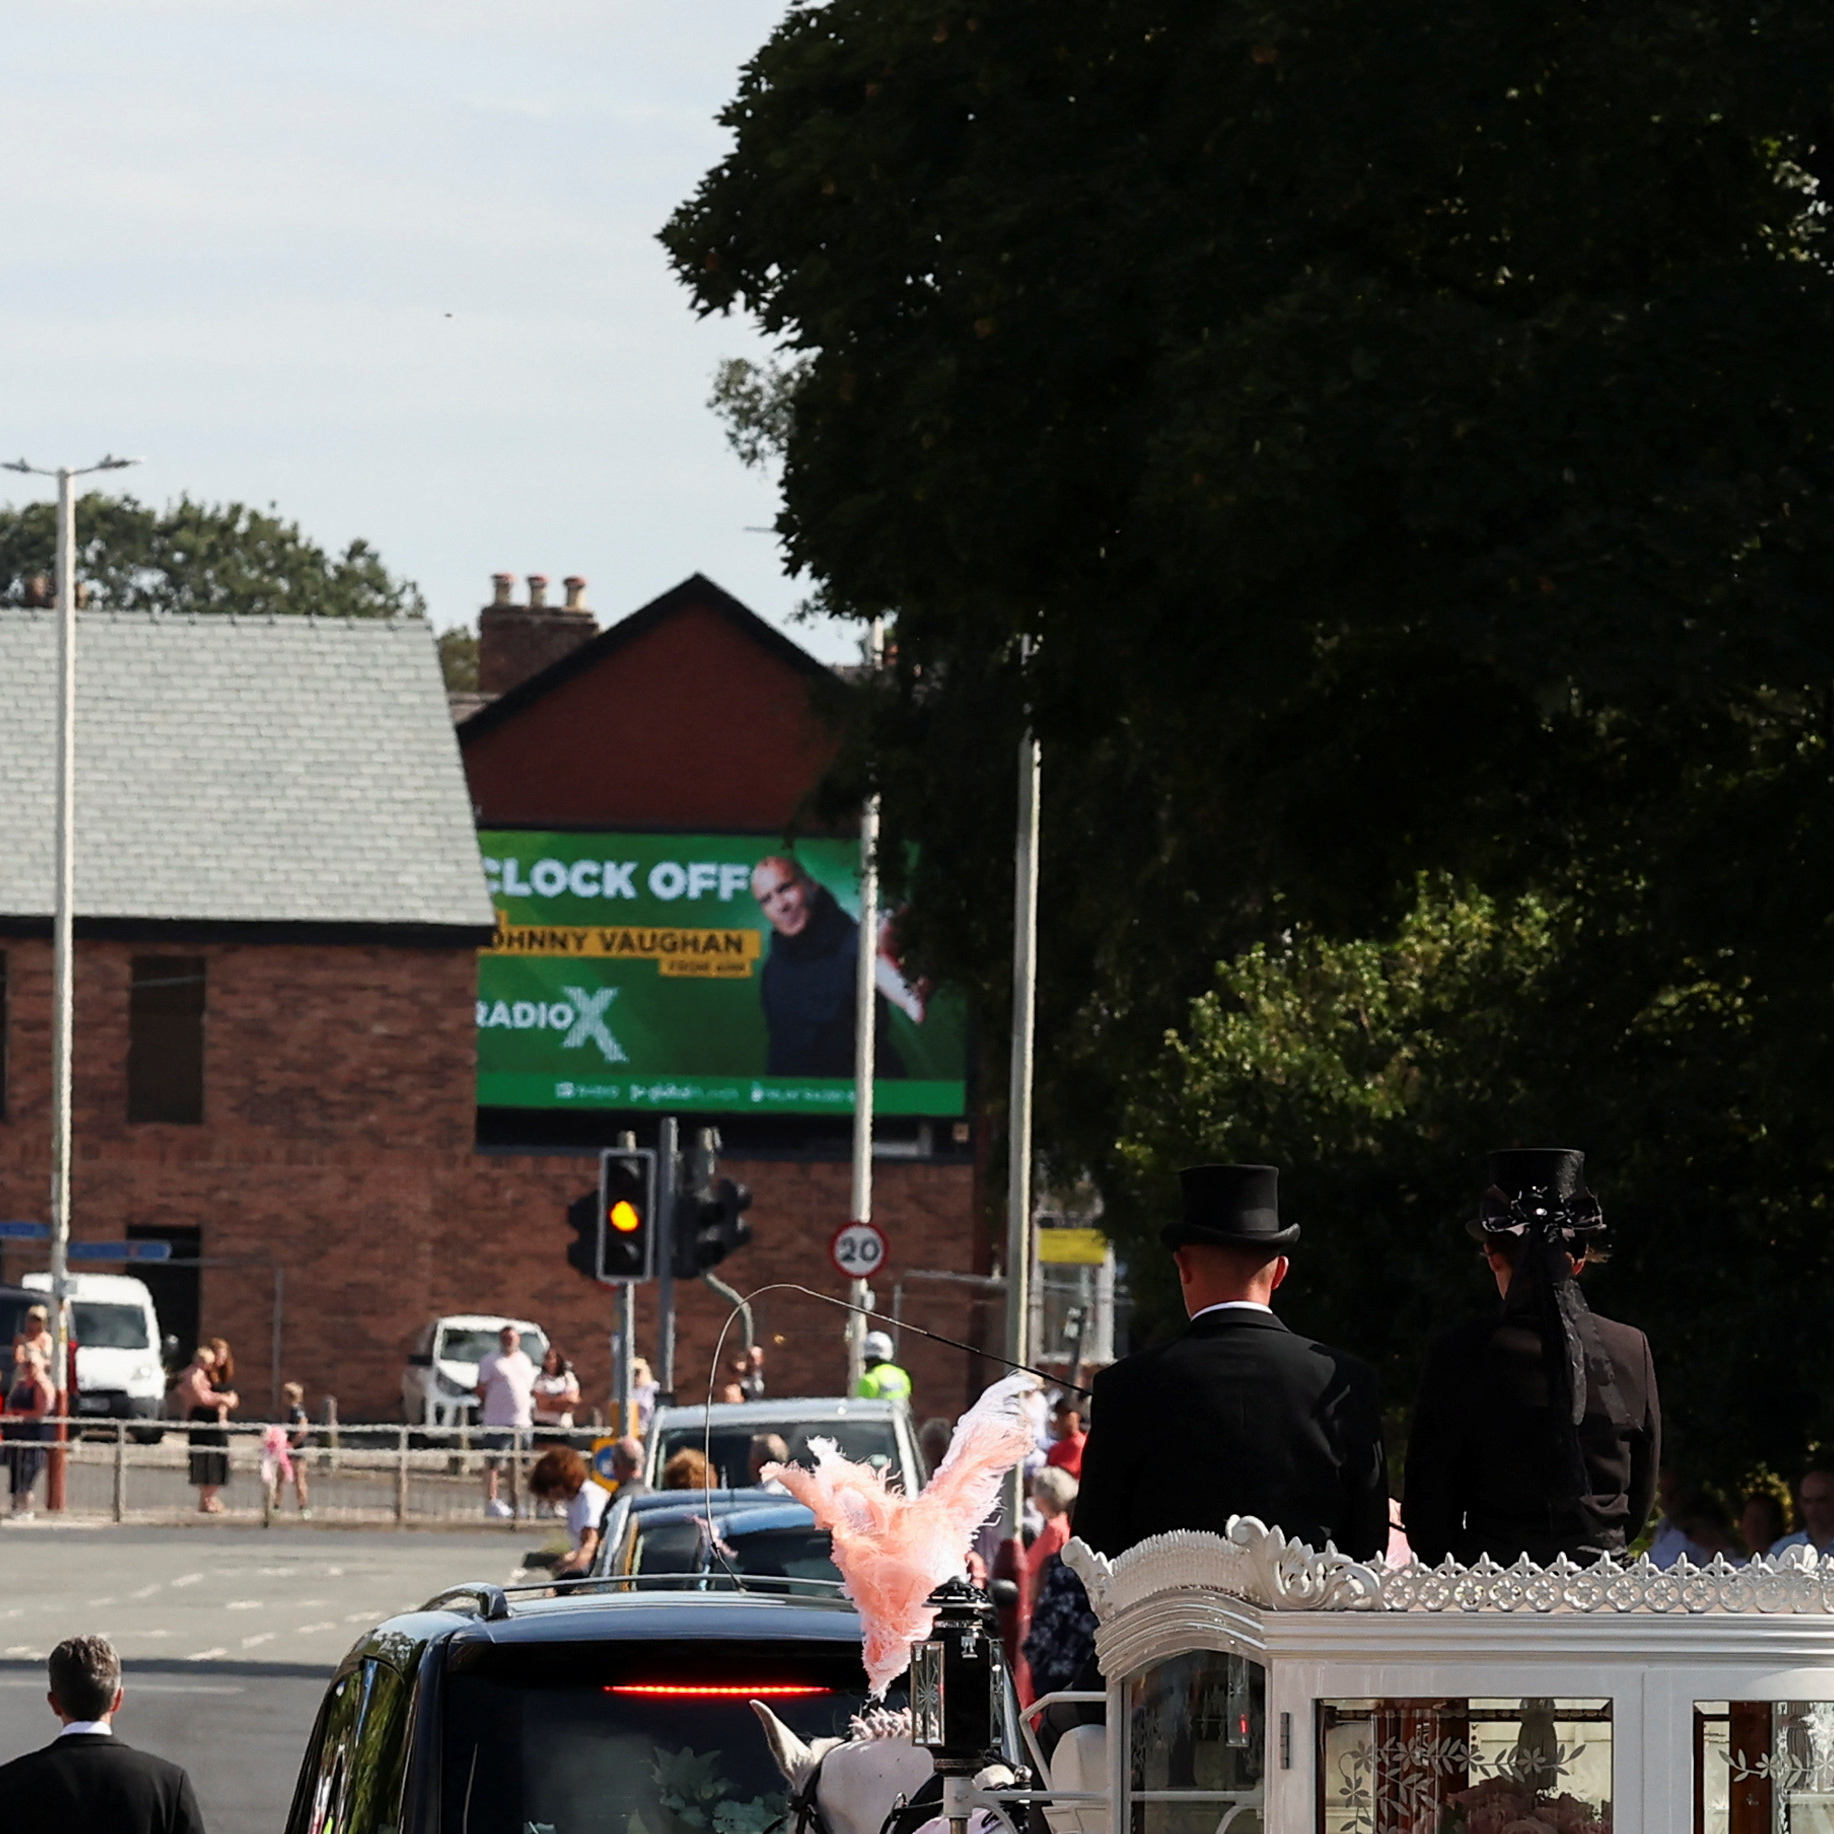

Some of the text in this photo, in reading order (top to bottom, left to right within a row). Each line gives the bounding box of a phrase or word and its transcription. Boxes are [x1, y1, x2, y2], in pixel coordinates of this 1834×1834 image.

[647, 861, 752, 901] OFF
[598, 929, 744, 955] VAUGHAN
[562, 985, 630, 1063] X
[838, 1235, 880, 1263] 20
